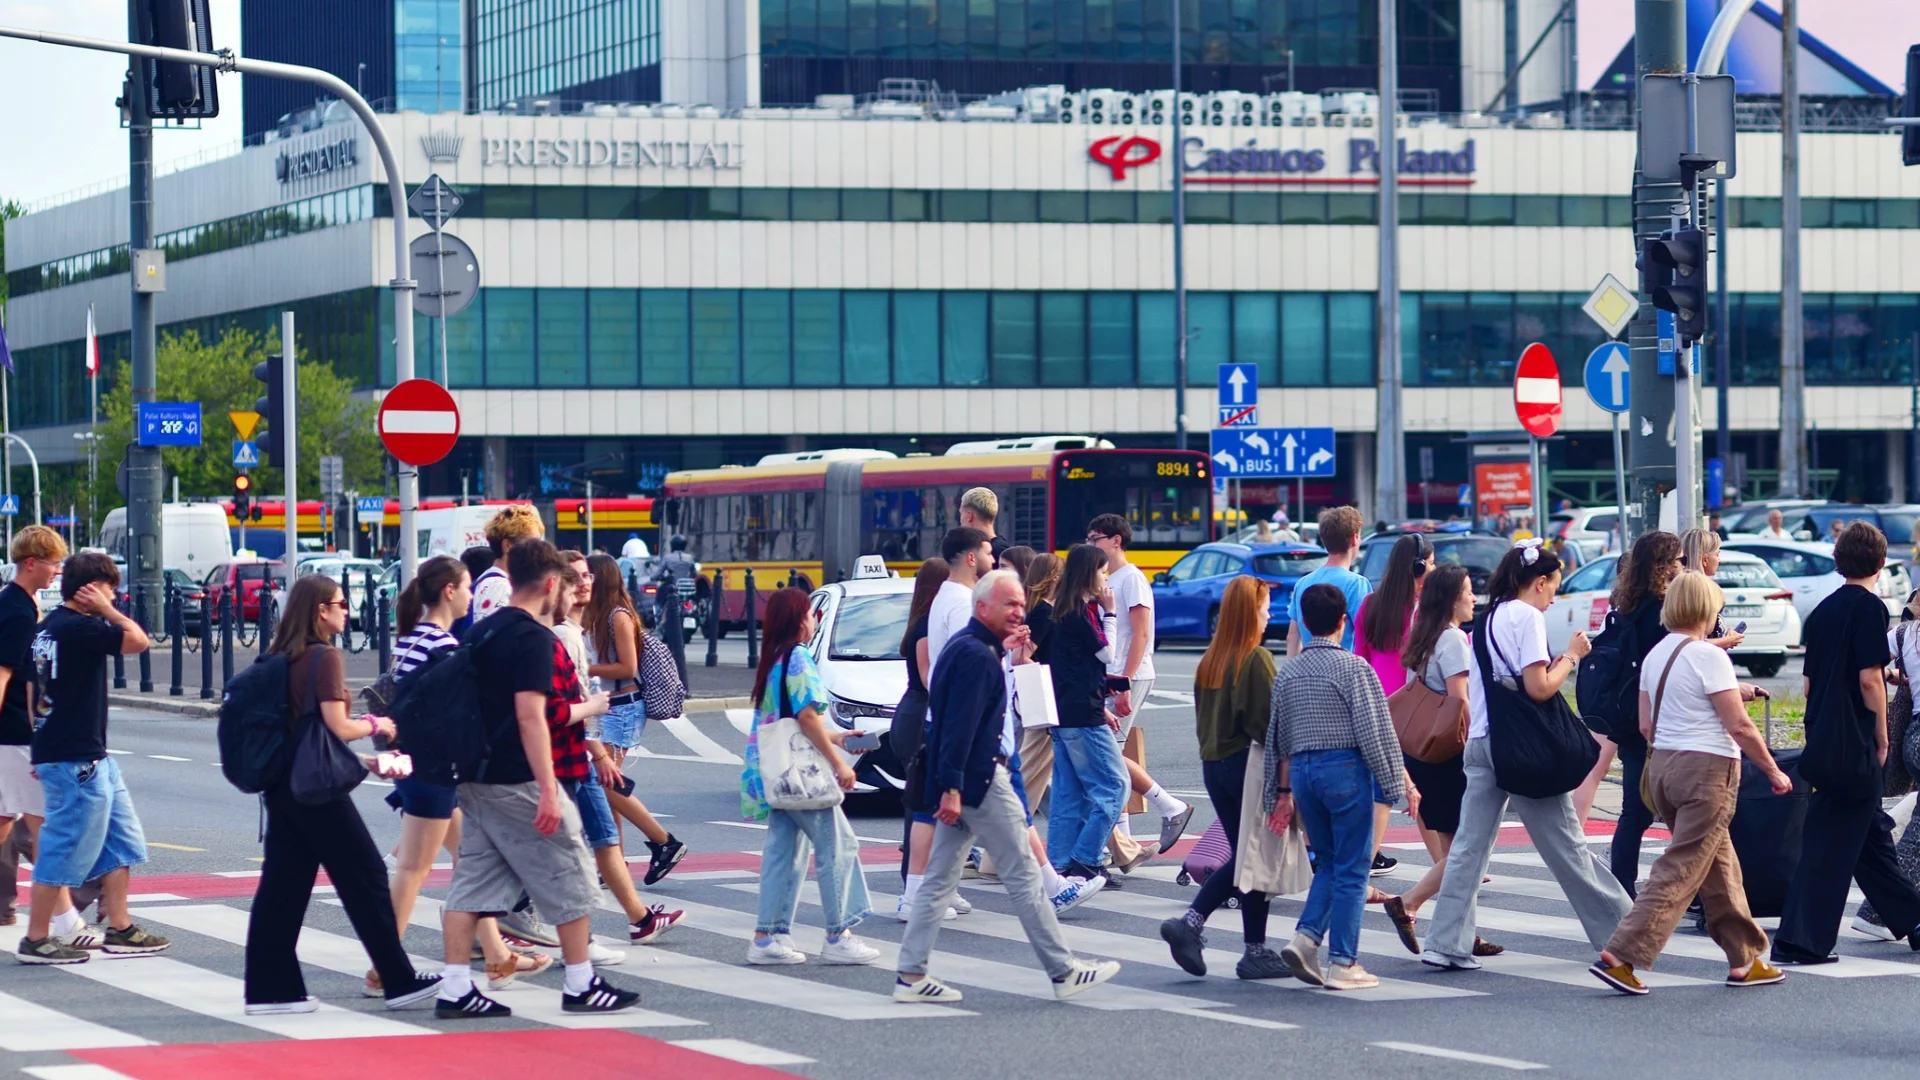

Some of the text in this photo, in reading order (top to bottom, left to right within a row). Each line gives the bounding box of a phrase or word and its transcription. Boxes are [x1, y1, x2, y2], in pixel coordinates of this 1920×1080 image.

[288, 138, 353, 181] PRESIDENTIAL
[484, 138, 742, 169] PRESIDENTIAL
[1182, 138, 1326, 174] Casinos
[1221, 408, 1257, 425] TAXI
[1157, 462, 1191, 477] 8894
[1246, 459, 1273, 472] BUS
[358, 498, 382, 510] TAXI
[863, 564, 882, 574] TAXI
